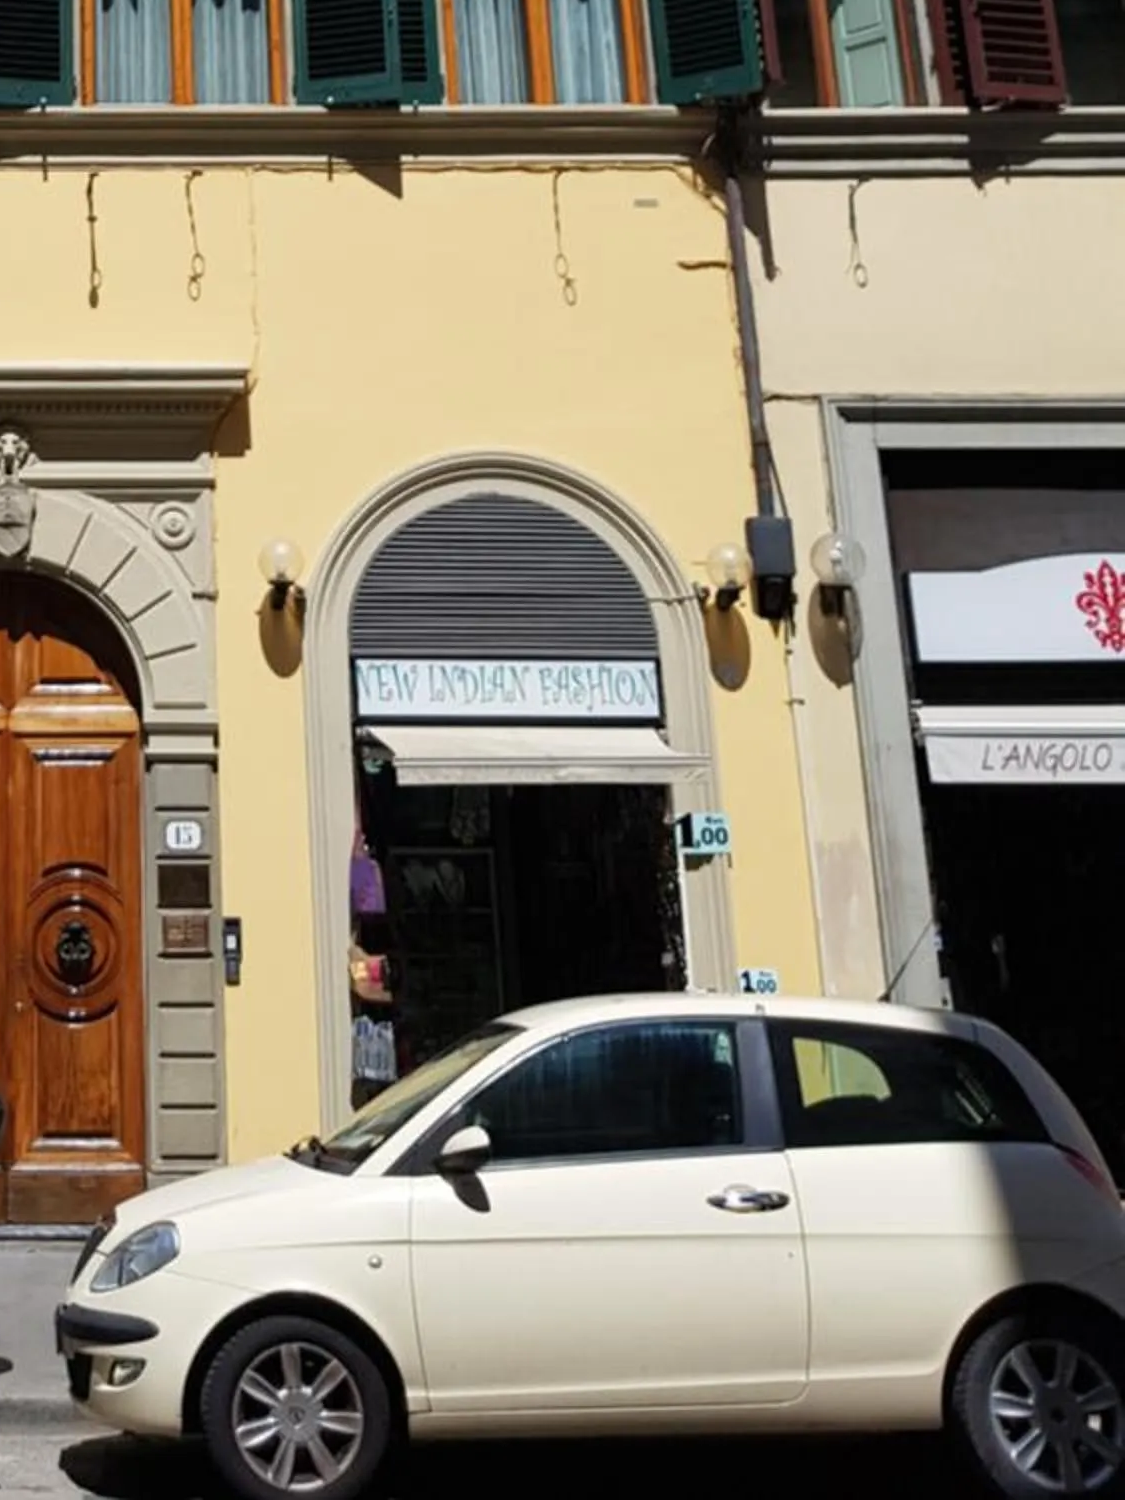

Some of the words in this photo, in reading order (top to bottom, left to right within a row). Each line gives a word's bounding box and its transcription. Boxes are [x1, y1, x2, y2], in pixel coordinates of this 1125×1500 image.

[356, 662, 419, 705] NEW
[428, 663, 530, 704] INDIAN
[538, 664, 656, 712] FASHION
[981, 742, 1113, 777] L'ANGOLO
